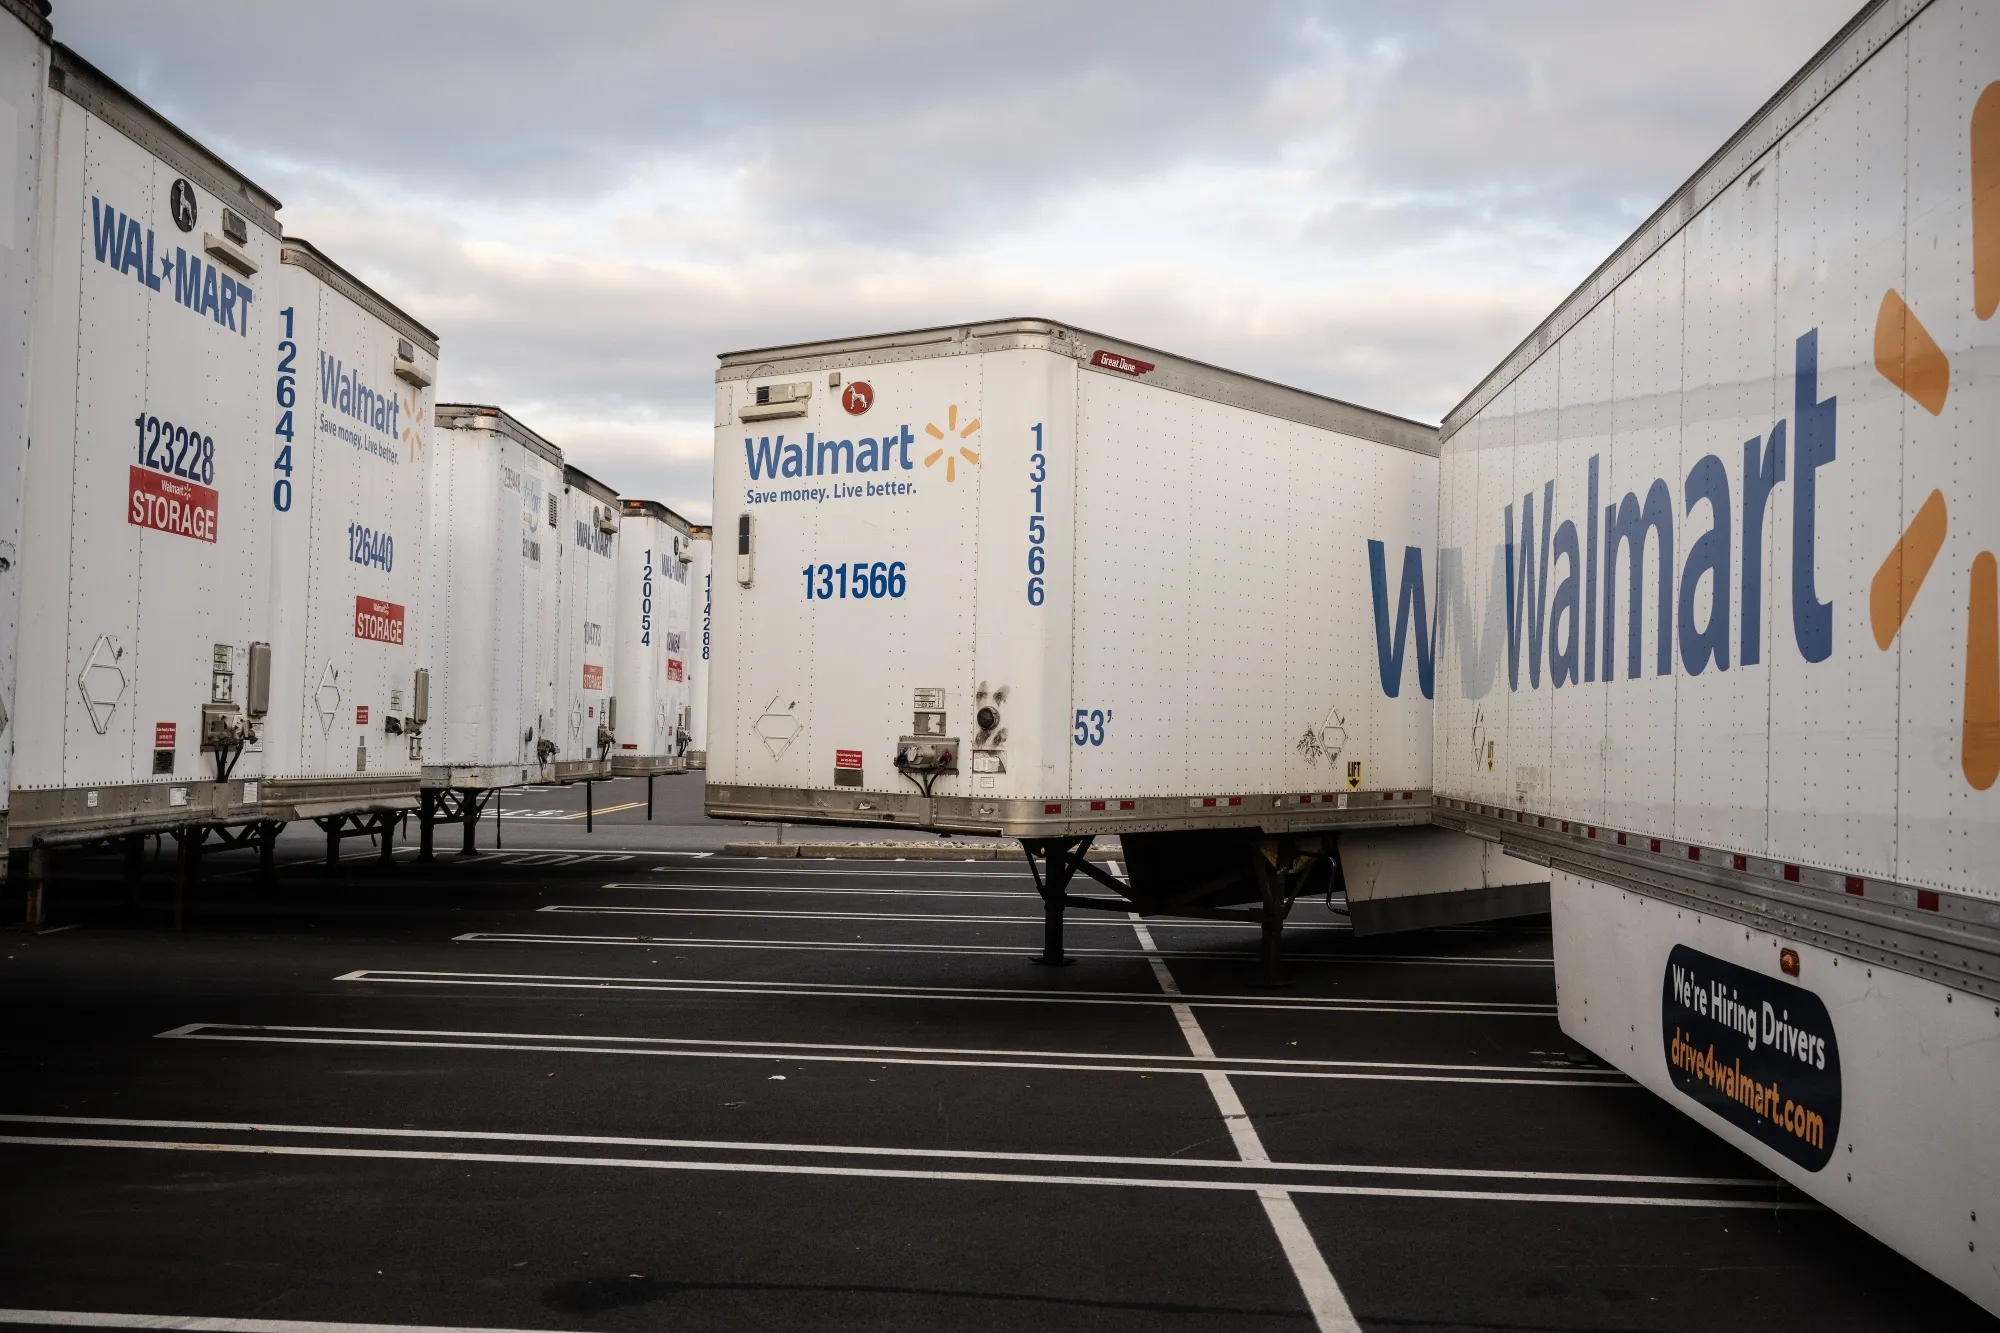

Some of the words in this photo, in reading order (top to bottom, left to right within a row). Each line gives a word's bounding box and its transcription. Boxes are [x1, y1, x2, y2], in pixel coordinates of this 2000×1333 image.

[1100, 353, 1119, 368] Great
[1119, 357, 1136, 373] Dane
[273, 306, 297, 512] 126440
[320, 350, 399, 440] Walmart
[134, 412, 214, 486] 123228
[320, 413, 337, 437] Save
[364, 433, 378, 456] Live
[379, 440, 399, 466] better.
[744, 425, 915, 481] Walmart
[132, 489, 215, 540] STORAGE
[161, 480, 184, 496] Walmart
[746, 489, 777, 504] Save
[780, 487, 830, 504] money.
[834, 482, 863, 499] Live
[866, 480, 917, 497] better.
[1027, 422, 1046, 606] 131566
[1503, 326, 1837, 693] Walmart
[348, 522, 393, 573] 126440
[641, 549, 652, 646] 120054
[802, 561, 906, 600] 131566
[357, 612, 403, 643] STORAGE
[702, 573, 711, 660] 114288
[1074, 709, 1112, 747] 53'
[1347, 761, 1361, 778] LIFT
[1672, 963, 1707, 1015] We're
[1711, 981, 1757, 1051] Hiring
[1762, 1001, 1825, 1070] Drivers
[1671, 1026, 1824, 1150] drive4walmart.com
